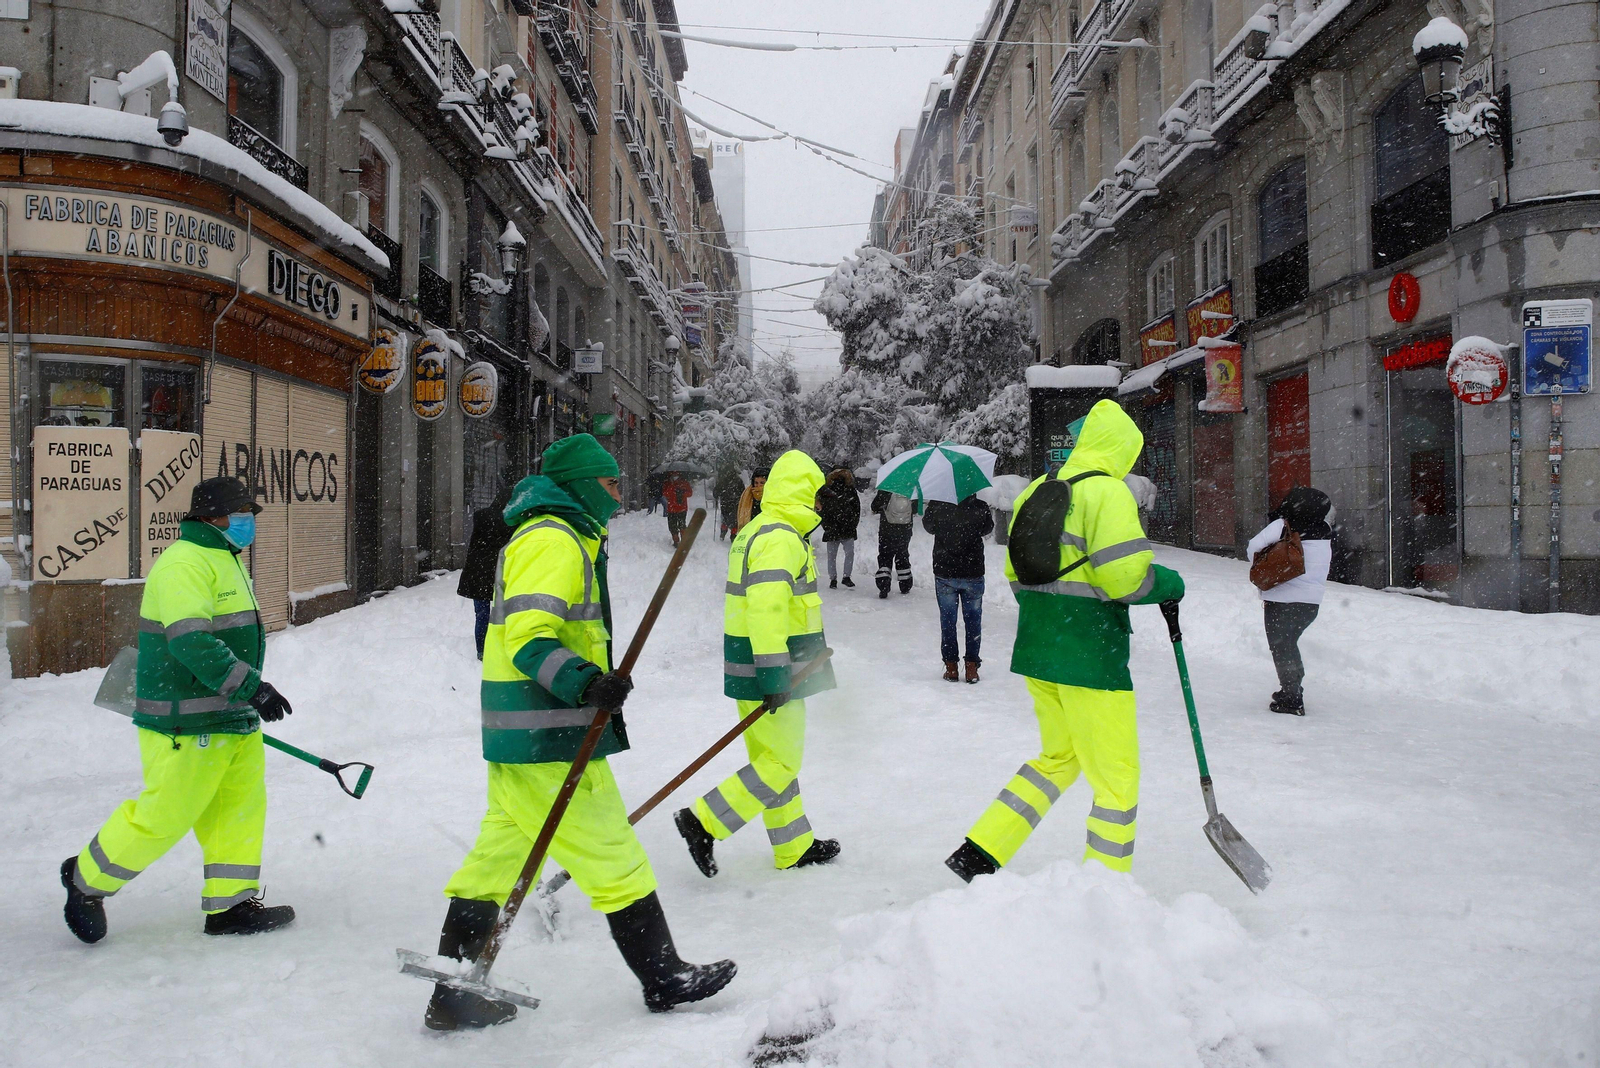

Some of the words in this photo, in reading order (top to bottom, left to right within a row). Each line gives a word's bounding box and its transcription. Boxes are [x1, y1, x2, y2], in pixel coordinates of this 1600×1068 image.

[189, 58, 225, 98] MONTERA
[190, 45, 210, 70] CALLE
[211, 62, 217, 74] DE
[217, 68, 224, 79] LA
[25, 195, 122, 227] FABRICA
[131, 204, 158, 232] DE
[165, 211, 236, 251] PARAGUAS
[86, 228, 208, 269] ABANICOS
[268, 250, 341, 319] DIEGO
[43, 366, 73, 378] CASA
[75, 367, 89, 379] DE
[91, 368, 121, 380] DIEGO
[417, 380, 445, 402] ORO
[48, 442, 113, 457] FABRICA
[71, 460, 91, 474] DE
[1051, 450, 1067, 460] EL
[40, 477, 121, 491] PARAGUAS
[145, 438, 200, 503] DIEGO
[217, 440, 338, 504] ABANICOS
[38, 519, 120, 578] CASA
[106, 507, 128, 527] DE
